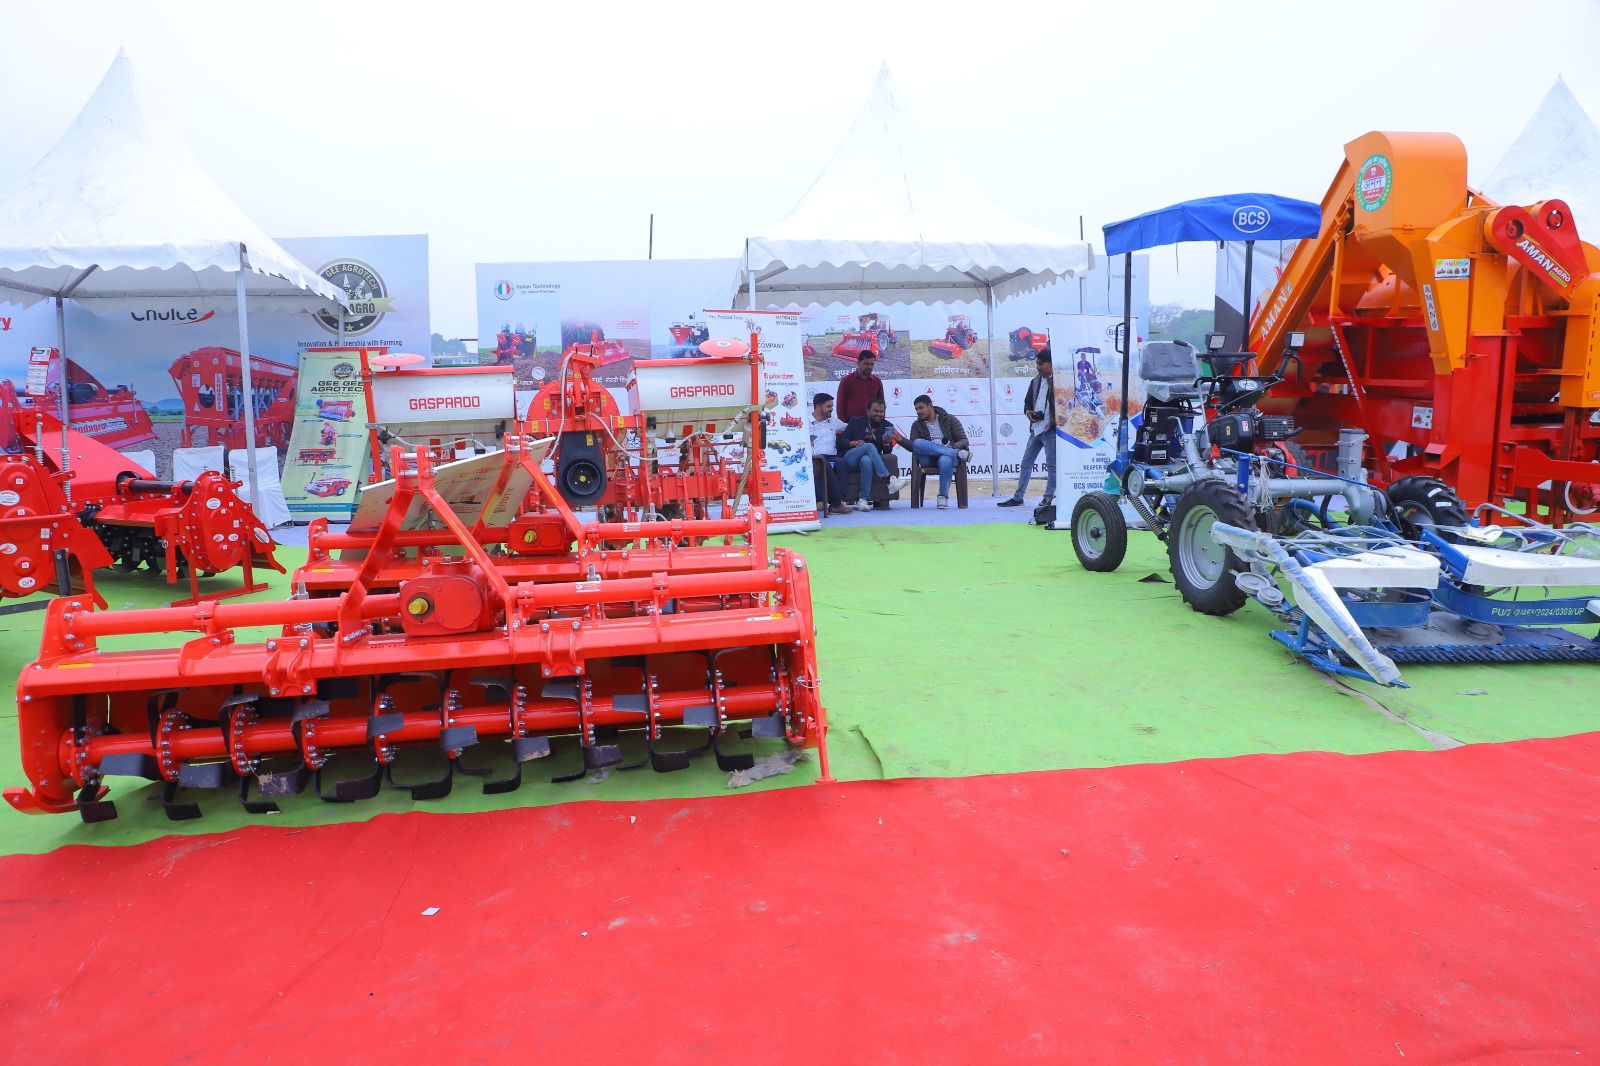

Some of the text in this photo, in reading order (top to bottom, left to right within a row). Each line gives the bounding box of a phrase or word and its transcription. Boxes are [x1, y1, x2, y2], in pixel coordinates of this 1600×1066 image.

[1238, 211, 1265, 226] BCS
[1518, 239, 1554, 271] AMAN
[1553, 266, 1571, 283] AGRO
[325, 264, 379, 290] GEE AGROTECH
[1424, 285, 1437, 318] AMAN
[1260, 290, 1289, 341] AMAN
[298, 340, 327, 348] Innovation
[380, 339, 403, 348] Farming
[669, 384, 735, 398] GASPARDO
[409, 395, 481, 411] GASPARDO
[1073, 482, 1086, 490] BCS
